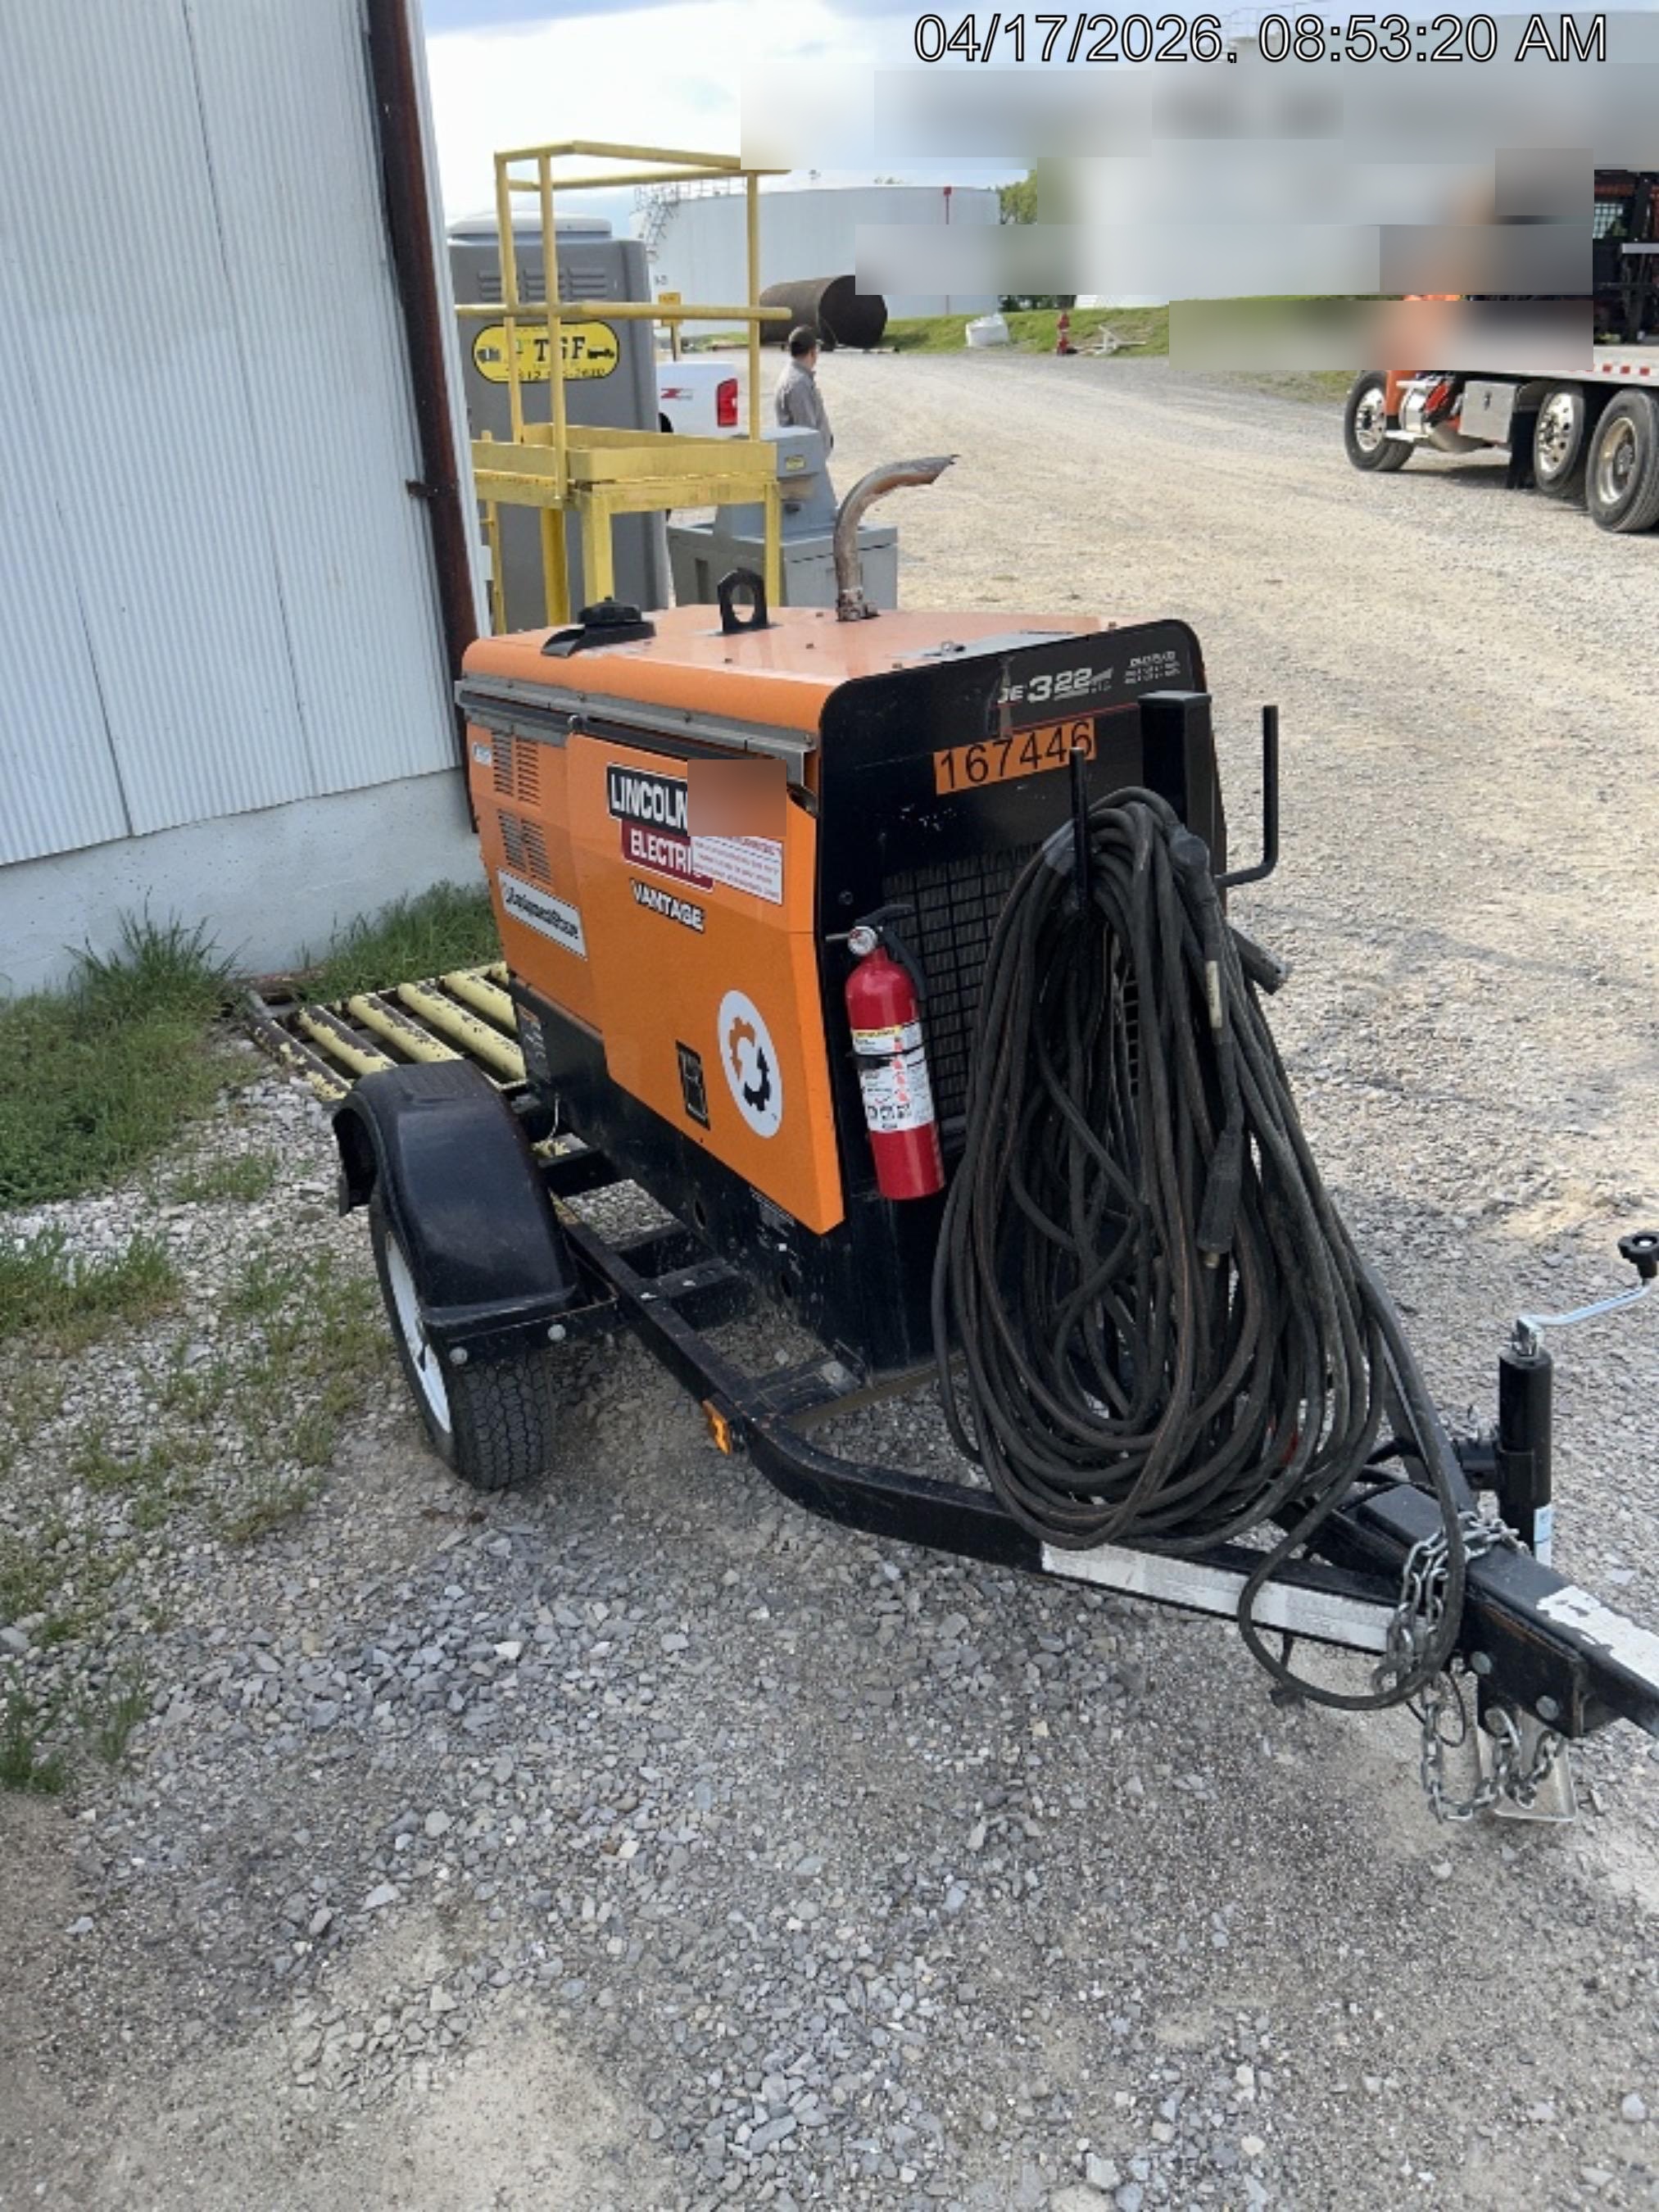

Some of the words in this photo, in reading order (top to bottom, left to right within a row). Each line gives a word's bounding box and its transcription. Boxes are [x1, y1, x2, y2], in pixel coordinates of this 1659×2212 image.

[1027, 667, 1093, 704] 322
[940, 721, 1093, 789] 167446
[610, 773, 688, 829] LINCOLN
[630, 827, 702, 877] ELECTRI
[631, 878, 705, 933] VANTAGE
